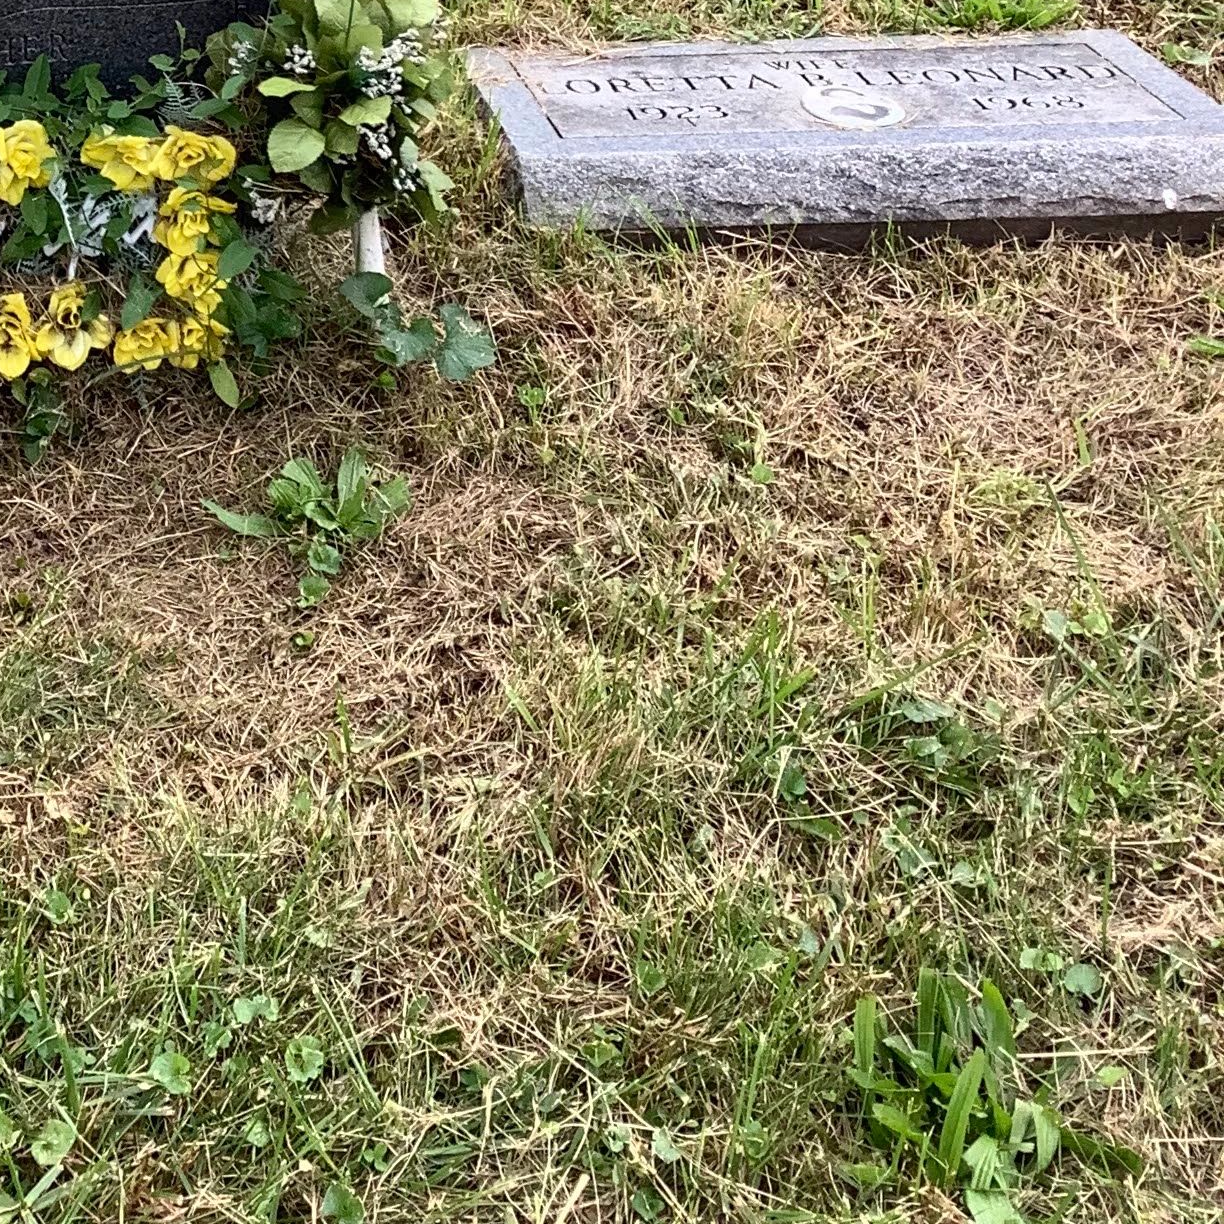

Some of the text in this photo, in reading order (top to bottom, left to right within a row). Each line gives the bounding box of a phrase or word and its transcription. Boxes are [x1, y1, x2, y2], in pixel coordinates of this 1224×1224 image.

[763, 57, 849, 72] WIFE
[540, 72, 782, 95] LORETTA
[854, 64, 1120, 87] LEONARD
[626, 94, 1086, 122] 1923 1968
